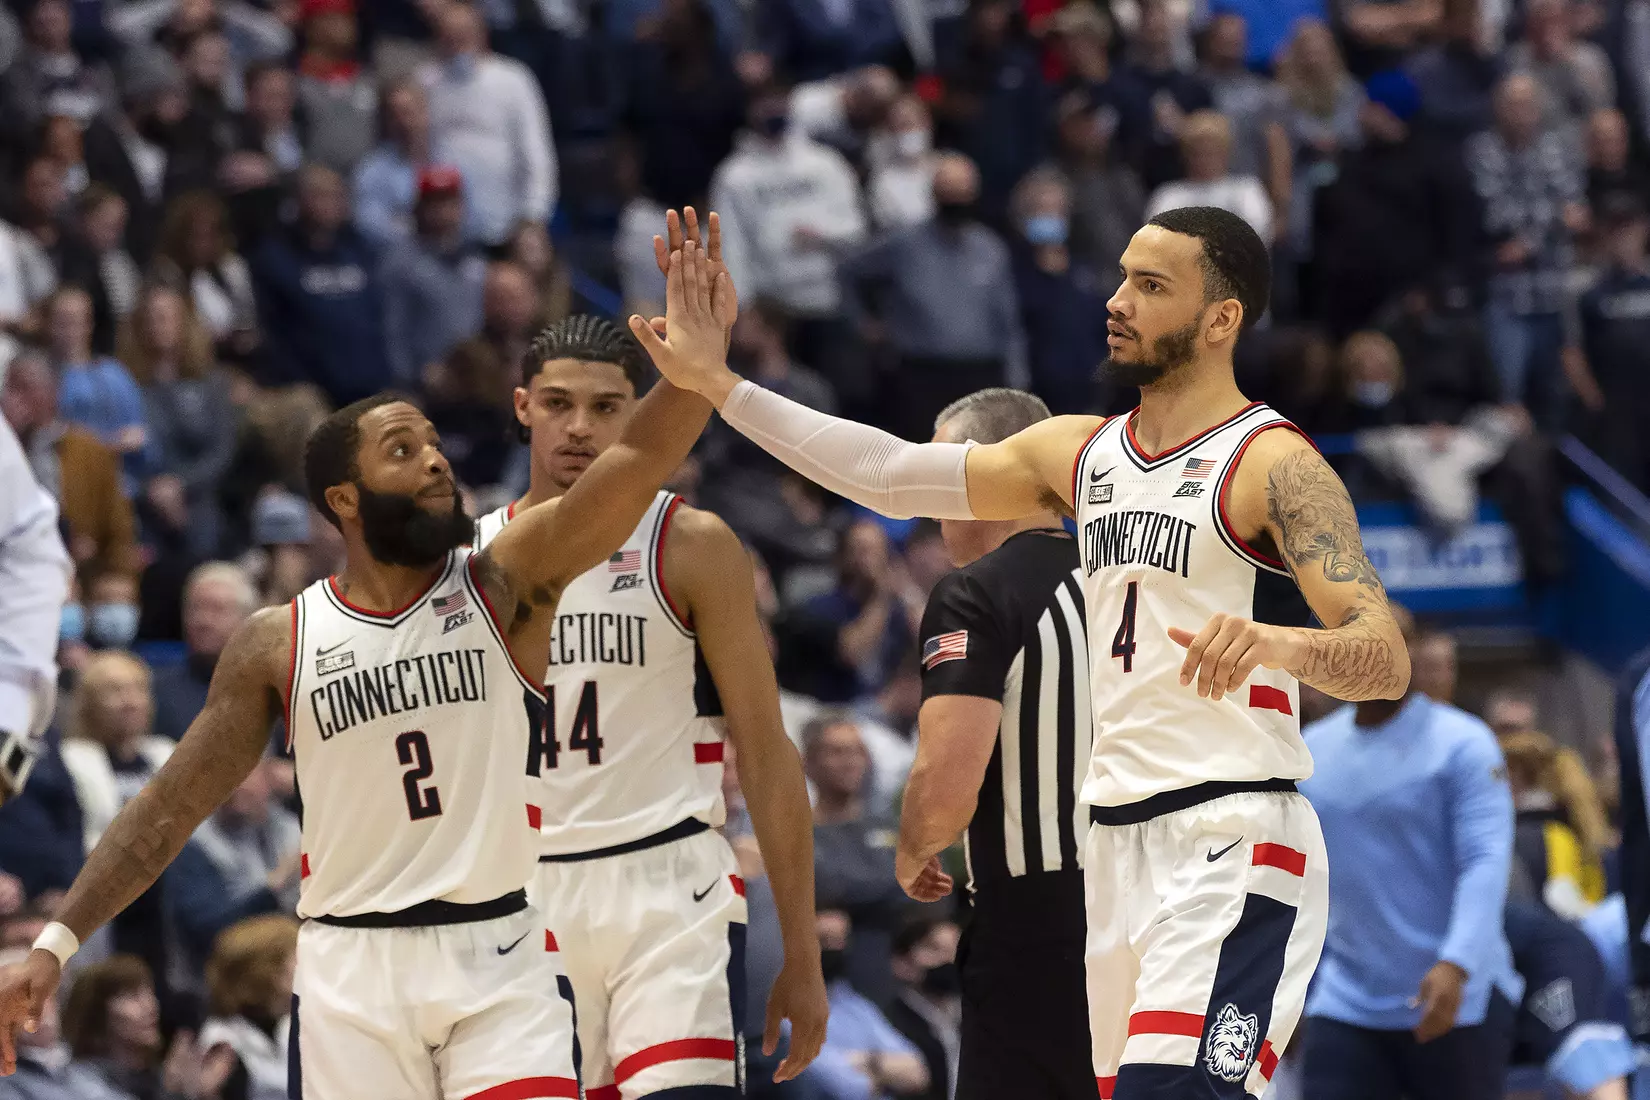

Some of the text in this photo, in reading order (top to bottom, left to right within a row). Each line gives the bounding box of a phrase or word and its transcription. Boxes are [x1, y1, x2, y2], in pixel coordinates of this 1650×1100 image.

[1084, 511, 1197, 579] CONNECTICUT
[1111, 580, 1138, 674] 4
[310, 649, 487, 741] CONNECTICUT
[395, 730, 443, 821] 2
